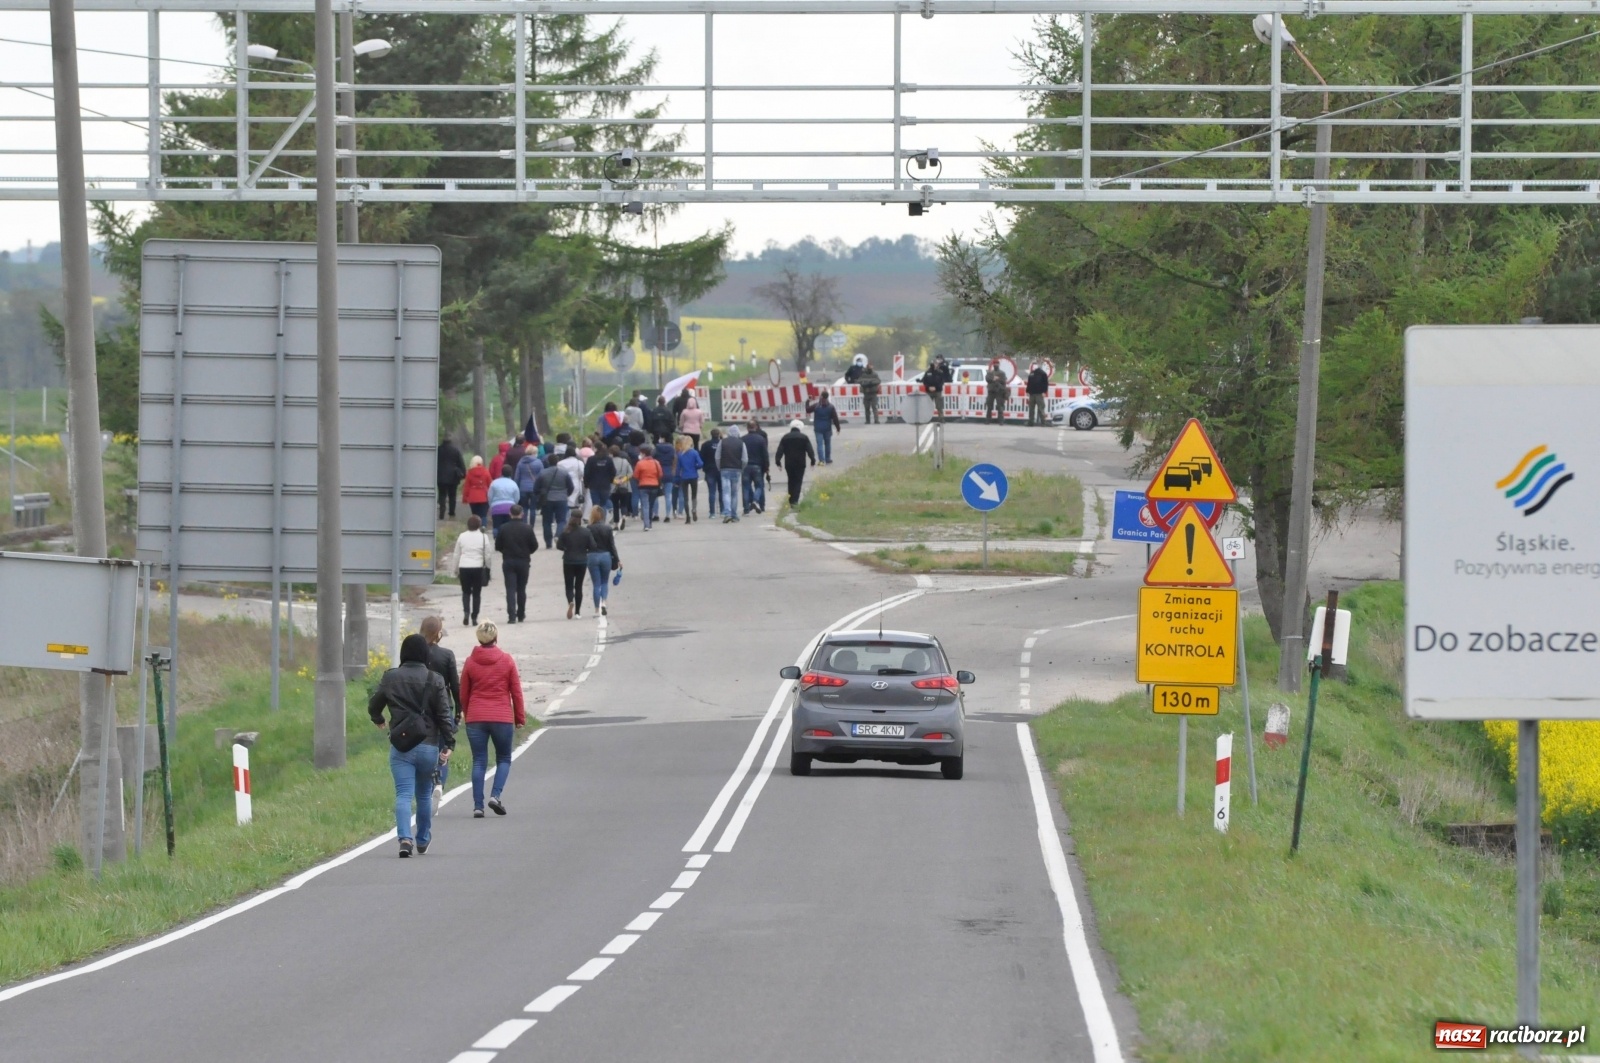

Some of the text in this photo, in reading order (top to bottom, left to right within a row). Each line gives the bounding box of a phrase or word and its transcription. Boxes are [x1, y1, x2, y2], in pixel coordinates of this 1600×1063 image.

[1117, 528, 1148, 537] Granica
[1496, 531, 1575, 555] Śląskie.
[1454, 559, 1547, 579] Pozytywna
[1164, 593, 1211, 605] Zmiana
[1152, 609, 1223, 623] organizacji
[1170, 624, 1204, 635] ruchu
[1414, 624, 1598, 652] Do zobacze
[1145, 643, 1225, 658] KONTROLA
[1161, 691, 1210, 708] 130 m
[858, 724, 878, 735] SRC
[880, 725, 904, 735] 4KN7
[1217, 806, 1226, 820] 6
